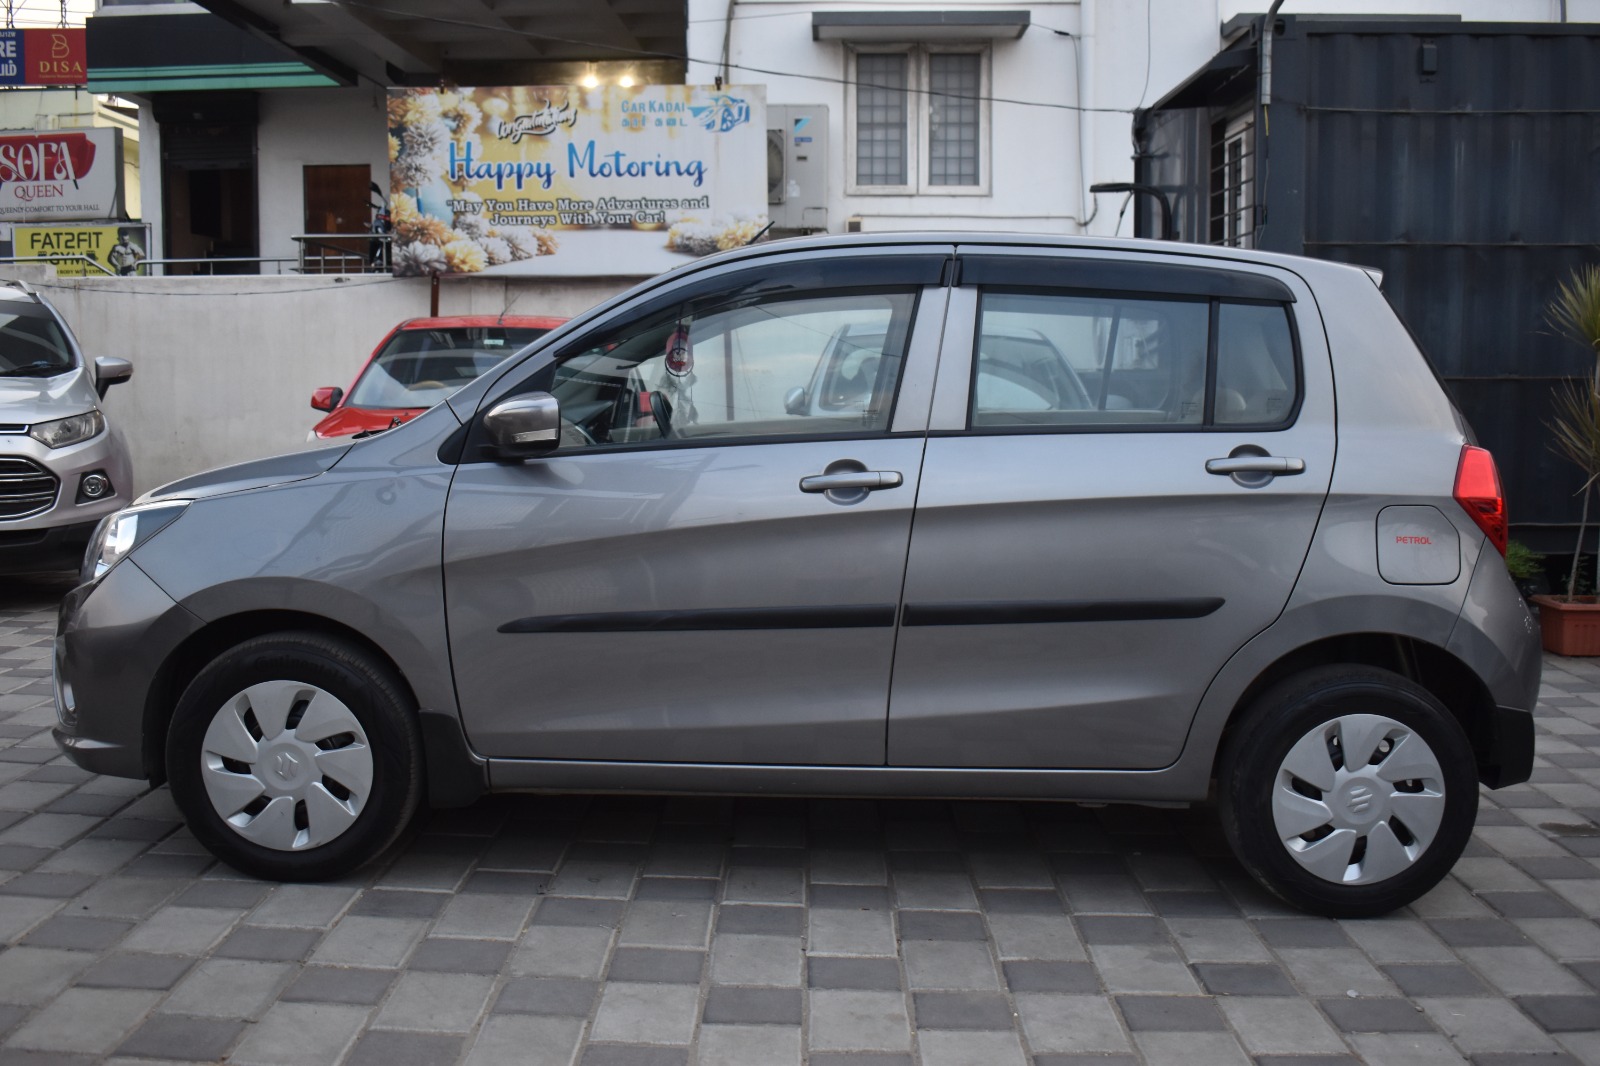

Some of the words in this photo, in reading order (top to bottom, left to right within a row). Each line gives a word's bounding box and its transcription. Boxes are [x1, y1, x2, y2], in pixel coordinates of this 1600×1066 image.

[39, 61, 83, 73] DISA
[0, 141, 77, 182] SOFA
[449, 141, 557, 190] Happy
[567, 140, 708, 187] Motoring
[14, 184, 64, 201] QUEEN
[24, 205, 54, 213] COMFORT
[83, 203, 100, 211] HALL
[486, 200, 513, 212] You
[517, 199, 554, 212] Have
[557, 199, 593, 212] More
[598, 197, 678, 211] Adventures
[683, 195, 710, 210] and
[490, 213, 556, 228] Journeys
[560, 212, 594, 225] With
[598, 211, 633, 224] Your
[635, 210, 666, 224] Car!
[30, 232, 103, 250] FAT2FIT
[1395, 535, 1432, 545] PETROL
